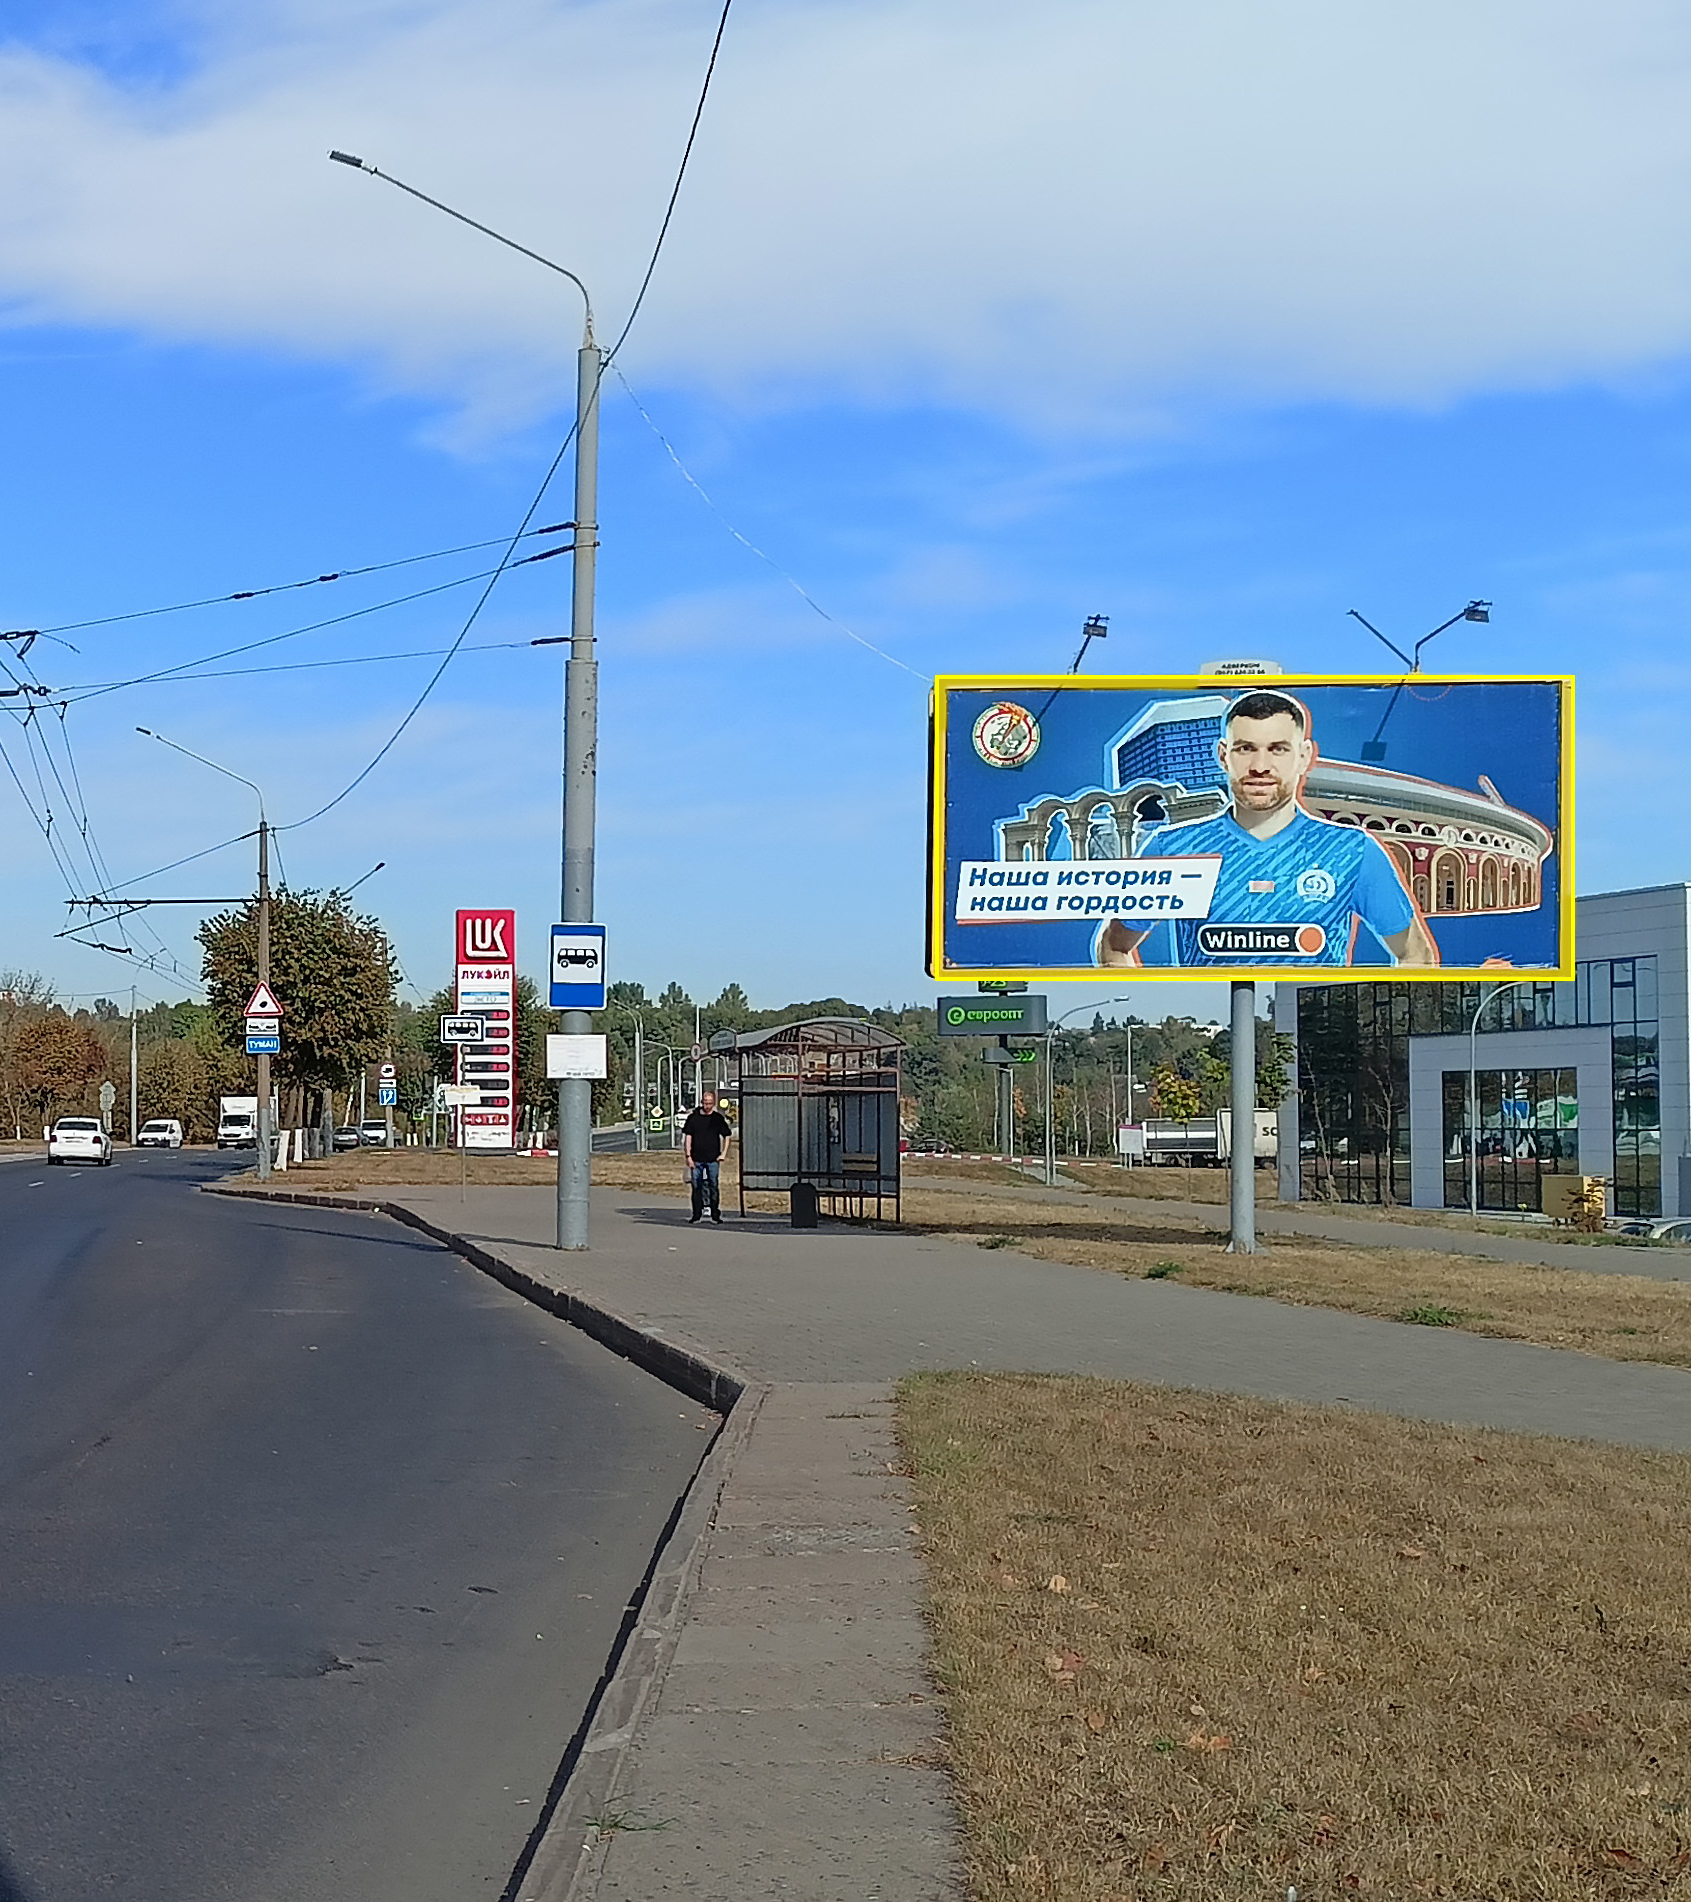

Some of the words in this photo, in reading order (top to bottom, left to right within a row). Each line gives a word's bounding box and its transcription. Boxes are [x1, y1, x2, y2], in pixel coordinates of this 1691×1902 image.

[969, 867, 1049, 887] Наша
[1057, 869, 1172, 889] история
[970, 895, 1048, 912] наша
[1056, 894, 1184, 915] гордость
[1205, 930, 1291, 949] Winline
[461, 968, 510, 980] ЛУКОЙЛ
